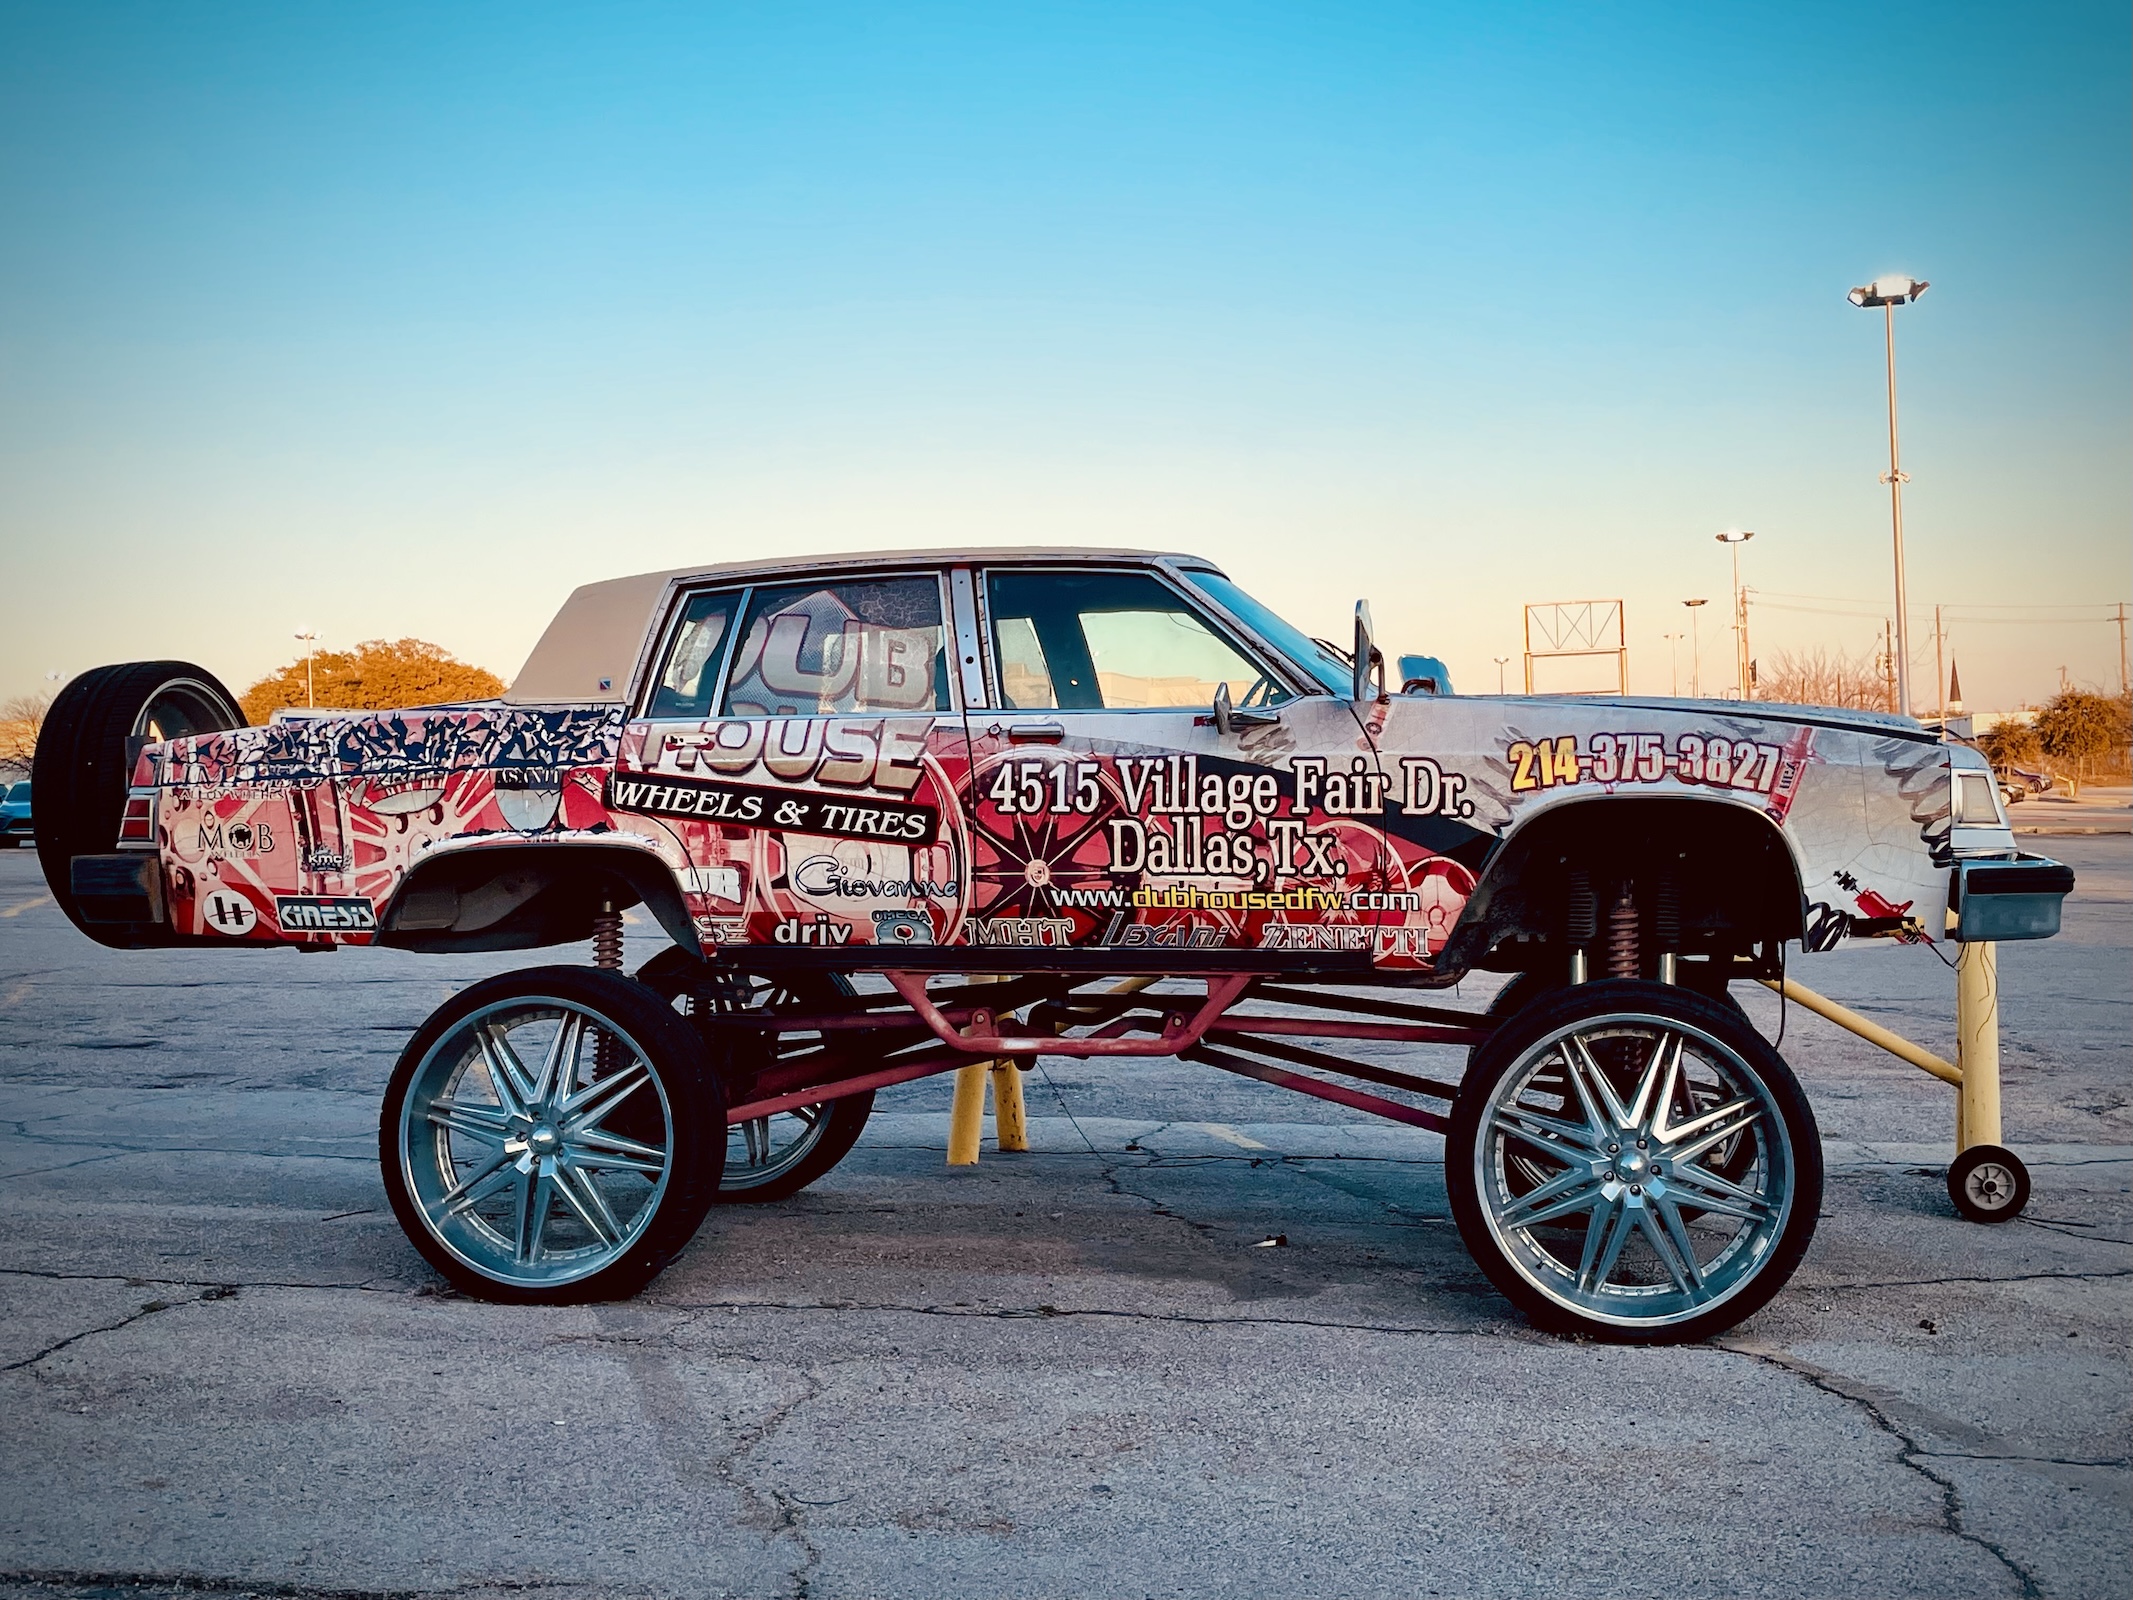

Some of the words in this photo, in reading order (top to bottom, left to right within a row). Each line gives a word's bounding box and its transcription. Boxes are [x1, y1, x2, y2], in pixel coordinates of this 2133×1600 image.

[1508, 732, 1783, 794] 214-375-3827
[614, 780, 763, 821] WHEELS
[774, 800, 809, 826] &
[821, 804, 927, 839] TIRES
[989, 761, 1102, 815] 4515
[1116, 757, 1278, 829] Village
[1291, 758, 1393, 815] Fair
[1402, 759, 1474, 818] Dr.
[796, 855, 960, 898] Giovanna
[1050, 884, 1419, 911] www.dubhousedfw.com
[871, 910, 932, 923] OMEGA
[967, 918, 1075, 947] MHT
